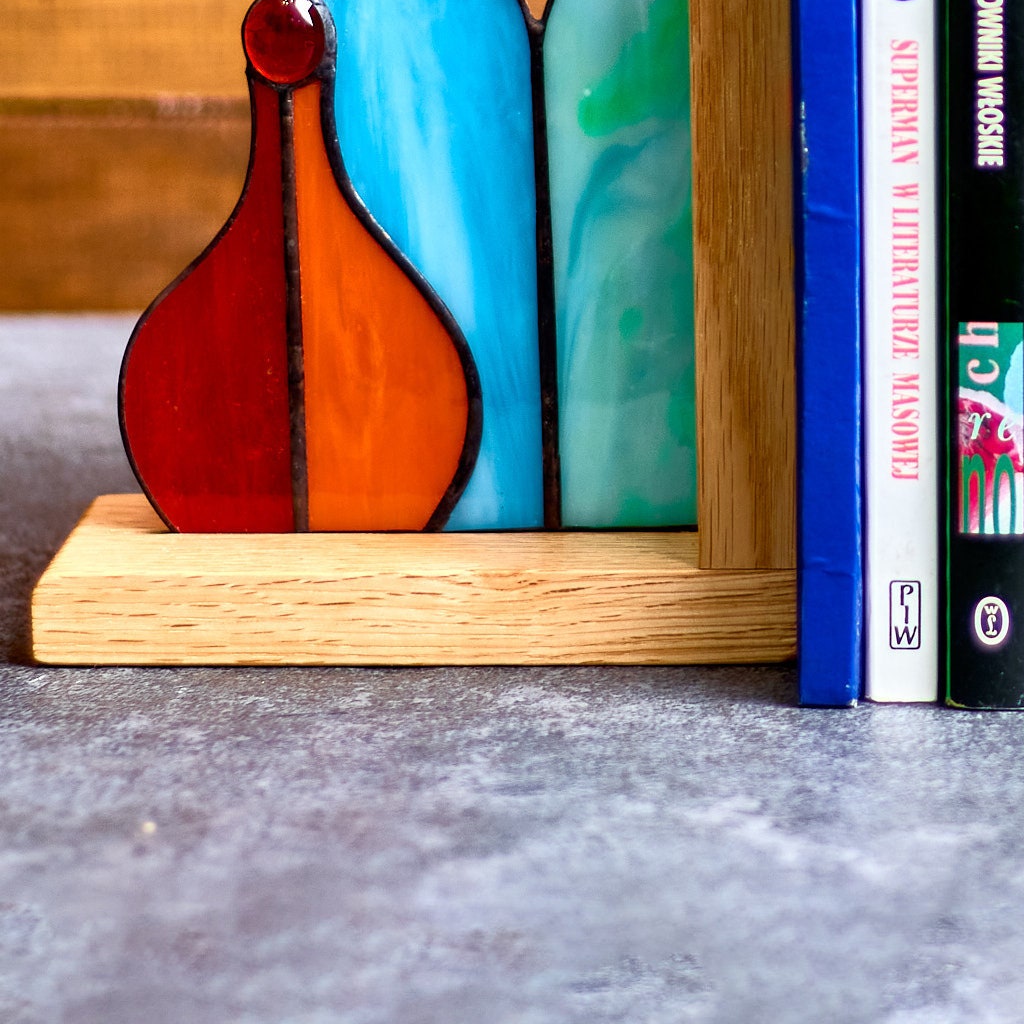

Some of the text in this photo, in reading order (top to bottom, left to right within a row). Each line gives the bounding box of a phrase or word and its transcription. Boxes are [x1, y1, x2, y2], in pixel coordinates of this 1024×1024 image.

[976, 75, 1004, 167] WŁOSKIE
[890, 40, 920, 482] SUPERMAN W LITERATURZE MASOWEJ
